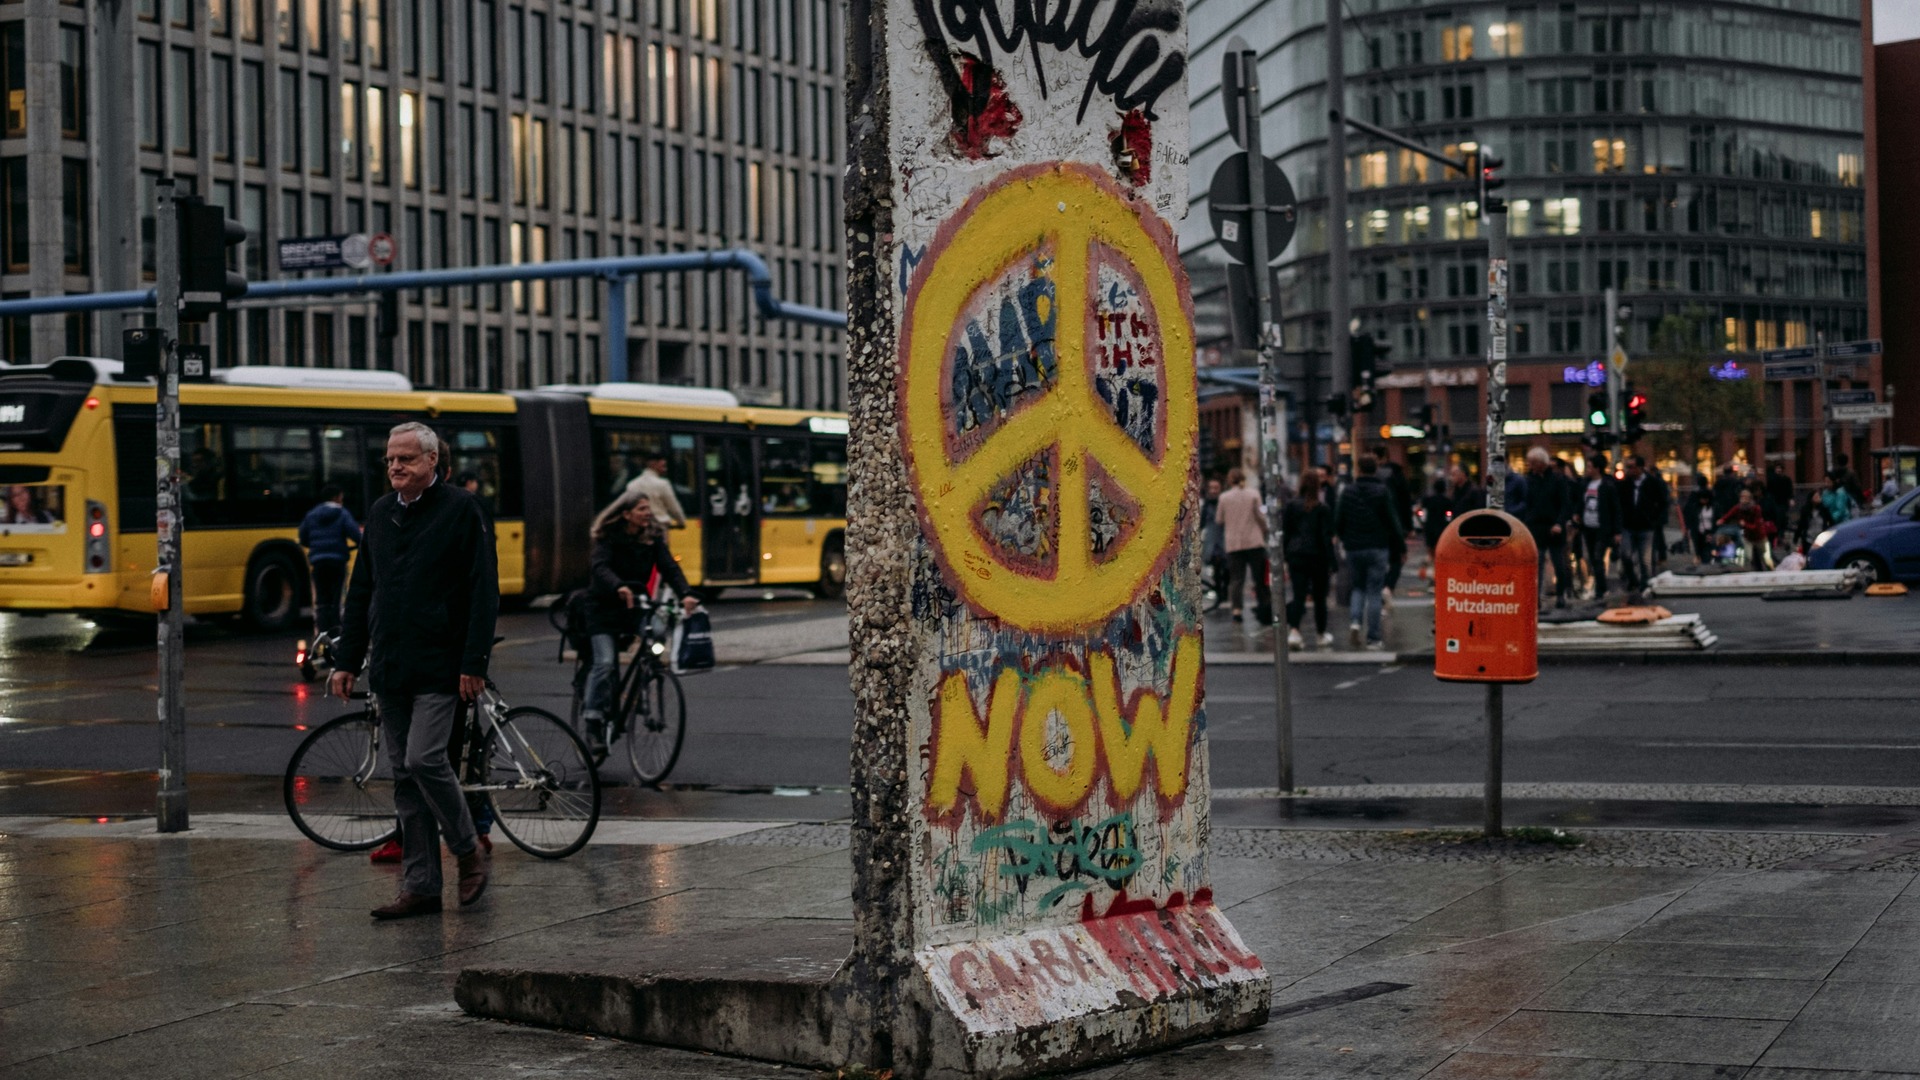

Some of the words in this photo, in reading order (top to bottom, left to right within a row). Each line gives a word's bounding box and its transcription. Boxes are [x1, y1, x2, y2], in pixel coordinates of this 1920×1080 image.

[940, 482, 955, 497] LOL
[1447, 578, 1514, 595] Boulevard
[1447, 597, 1520, 614] Putzdamer
[925, 633, 1204, 820] NOW
